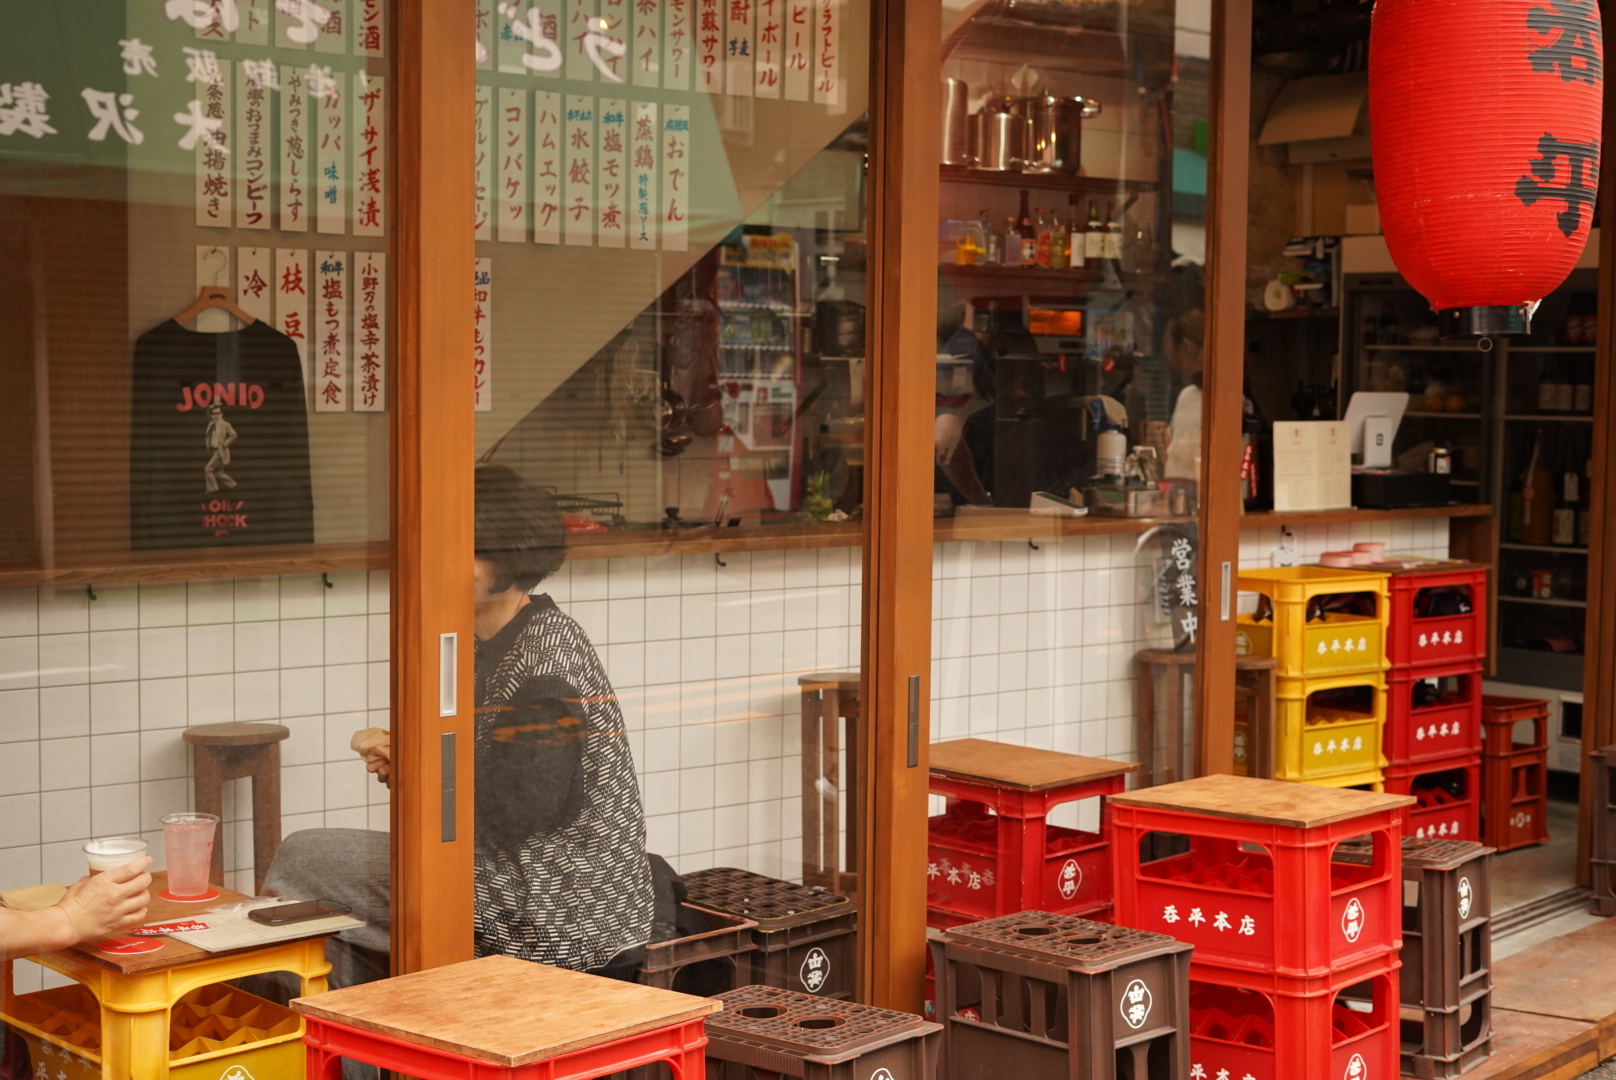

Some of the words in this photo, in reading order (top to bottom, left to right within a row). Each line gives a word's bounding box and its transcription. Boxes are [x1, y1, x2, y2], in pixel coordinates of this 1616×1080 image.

[790, 5, 807, 71] ビール
[358, 87, 382, 227] ザーサイ浅漬
[602, 111, 624, 128] 和牛
[634, 114, 654, 171] 蒸鶏
[540, 110, 558, 228] ハムエッグ
[568, 128, 591, 221] 水餃子
[602, 129, 623, 230] 塩モツ煮
[667, 136, 684, 222] おでん
[280, 263, 306, 340] 枝豆
[320, 260, 344, 277] 和牛
[321, 278, 344, 405] 塩もつ煮定食
[360, 263, 381, 408] 小野万の塩辛茶漬け
[175, 382, 265, 412] JONIO
[1171, 538, 1198, 644] 営業中
[1162, 904, 1256, 936] 呑平本店
